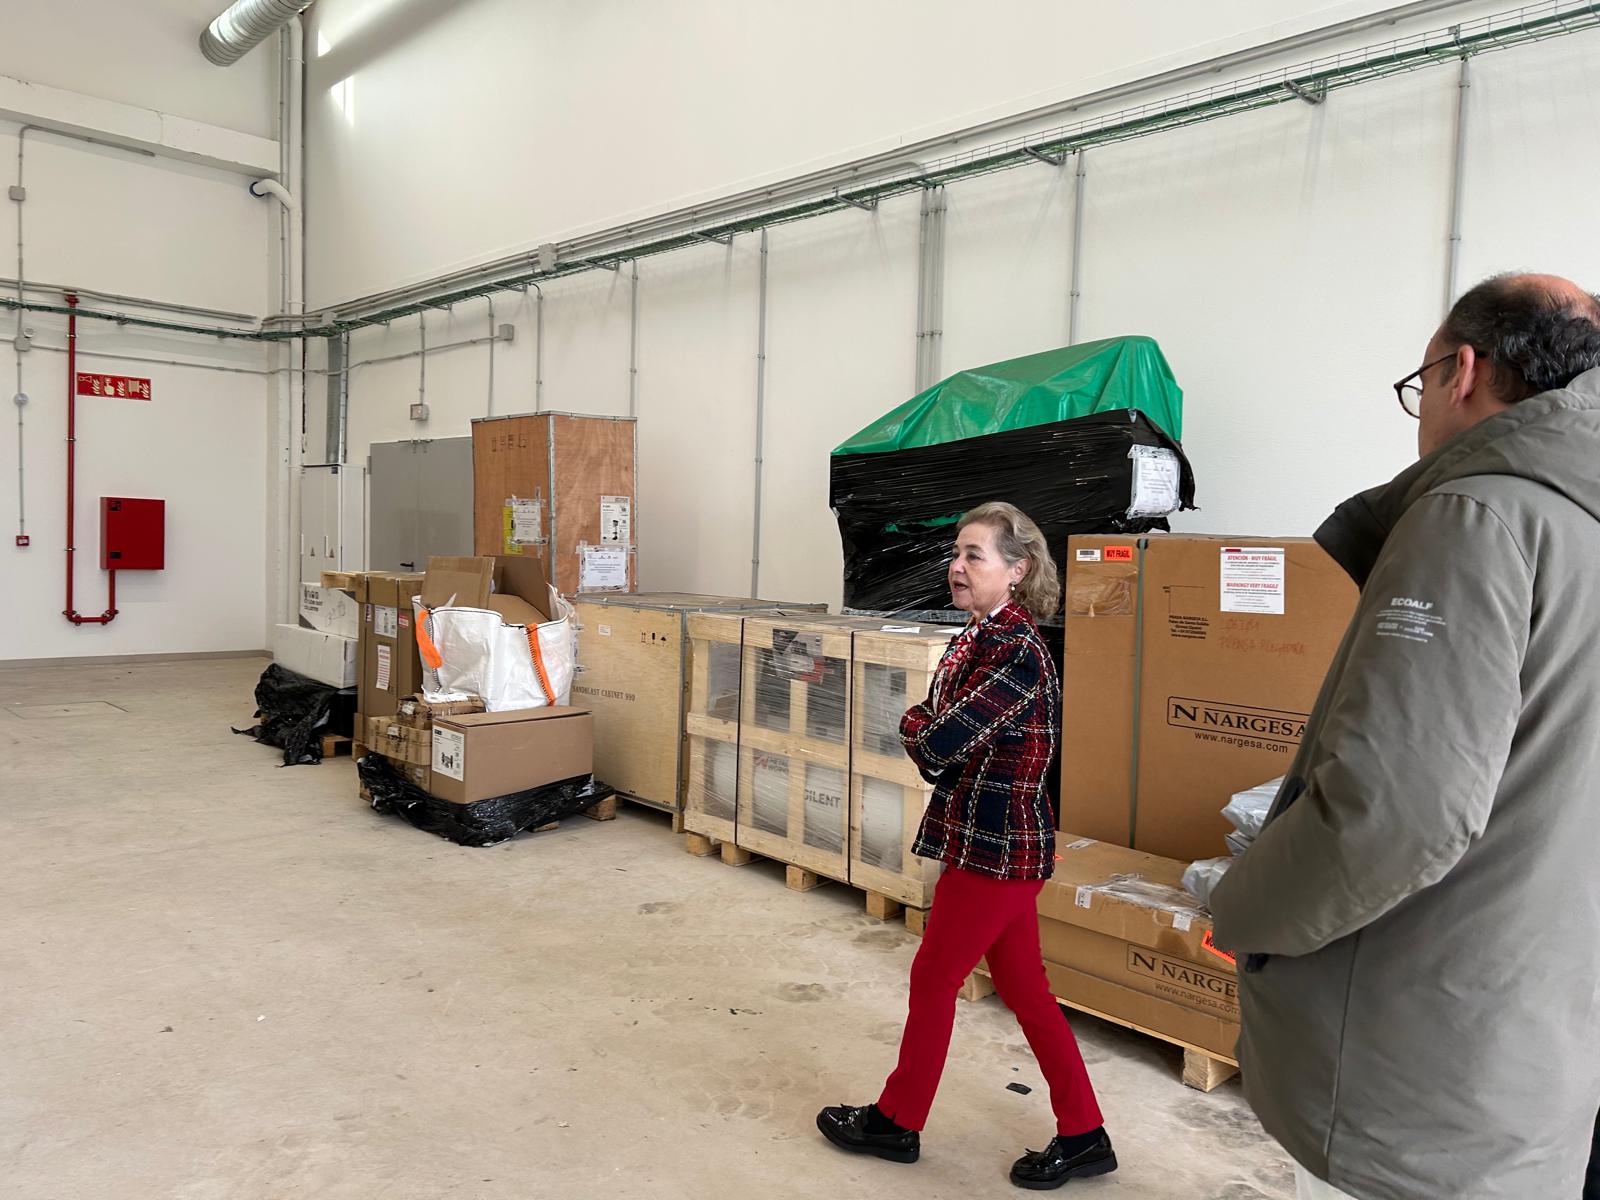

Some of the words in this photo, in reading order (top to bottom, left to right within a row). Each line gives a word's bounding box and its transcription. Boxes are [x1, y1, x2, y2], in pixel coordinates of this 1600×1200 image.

[1106, 549, 1115, 558] MUY
[1391, 597, 1434, 610] ECOALF
[601, 689, 624, 699] CABINET
[1203, 711, 1306, 738] NARGESA
[1194, 731, 1288, 753] www.nargesa.com
[1161, 964, 1237, 998] NARGE
